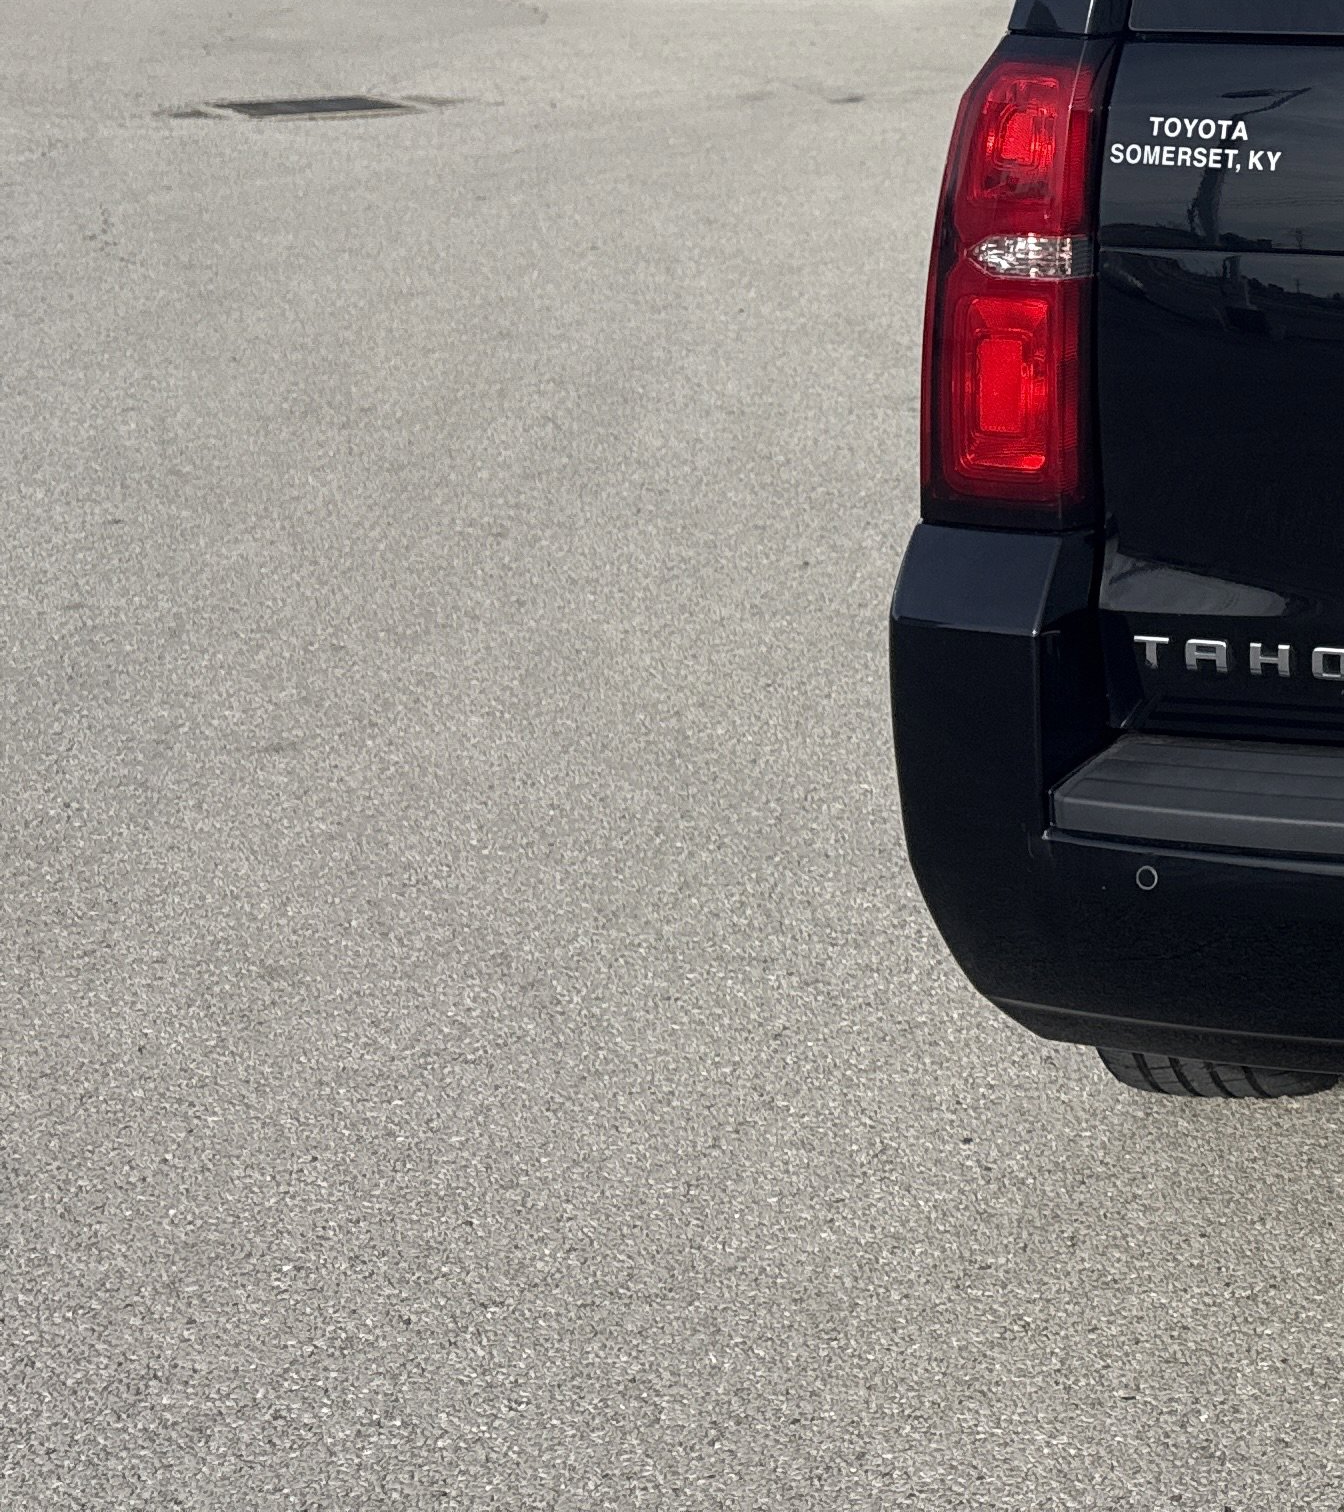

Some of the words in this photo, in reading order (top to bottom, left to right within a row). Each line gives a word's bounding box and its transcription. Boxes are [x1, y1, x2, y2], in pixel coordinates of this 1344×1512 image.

[1149, 116, 1249, 141] TOYOTA
[1109, 143, 1242, 173] SOMERSET,
[1248, 150, 1282, 171] KY
